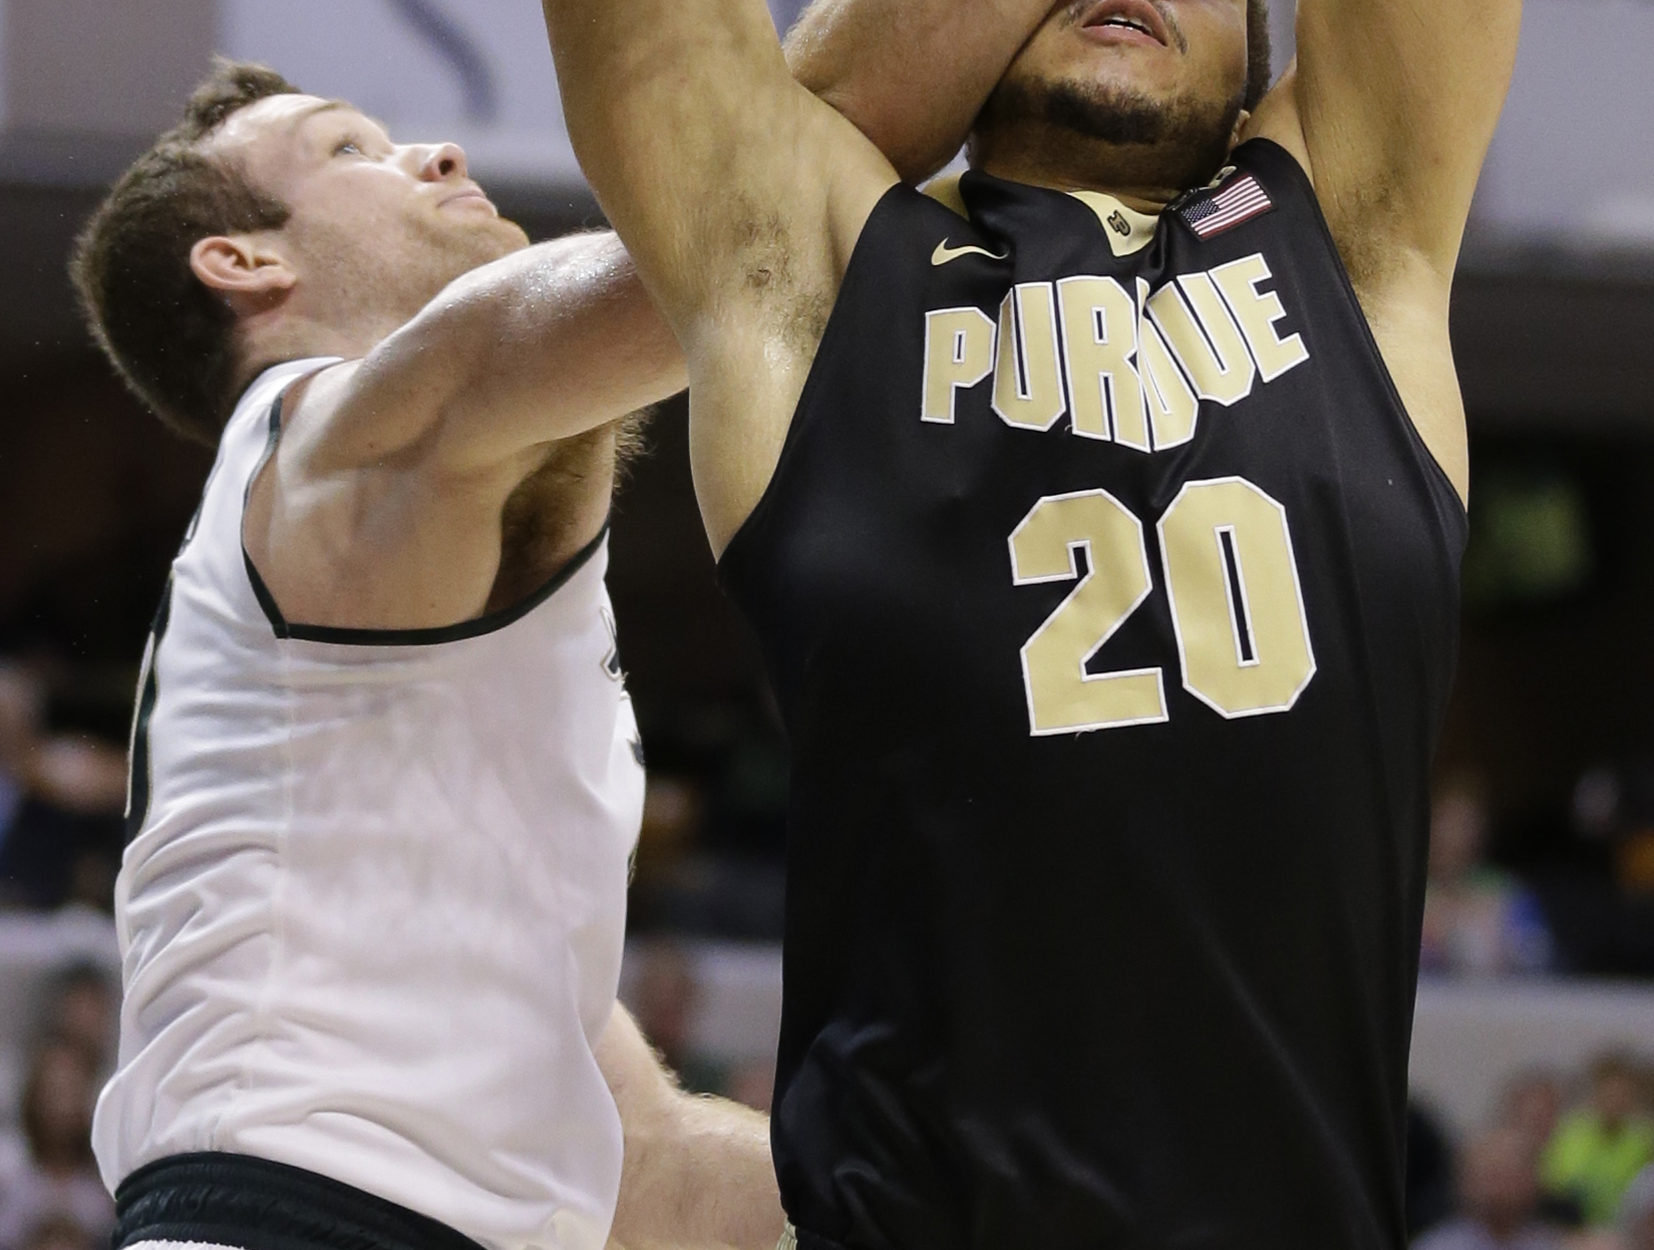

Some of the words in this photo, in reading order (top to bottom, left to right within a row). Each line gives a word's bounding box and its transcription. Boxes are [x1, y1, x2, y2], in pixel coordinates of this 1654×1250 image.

[1107, 209, 1132, 237] P
[920, 252, 1310, 454] PURDUE
[1008, 475, 1317, 736] 20
